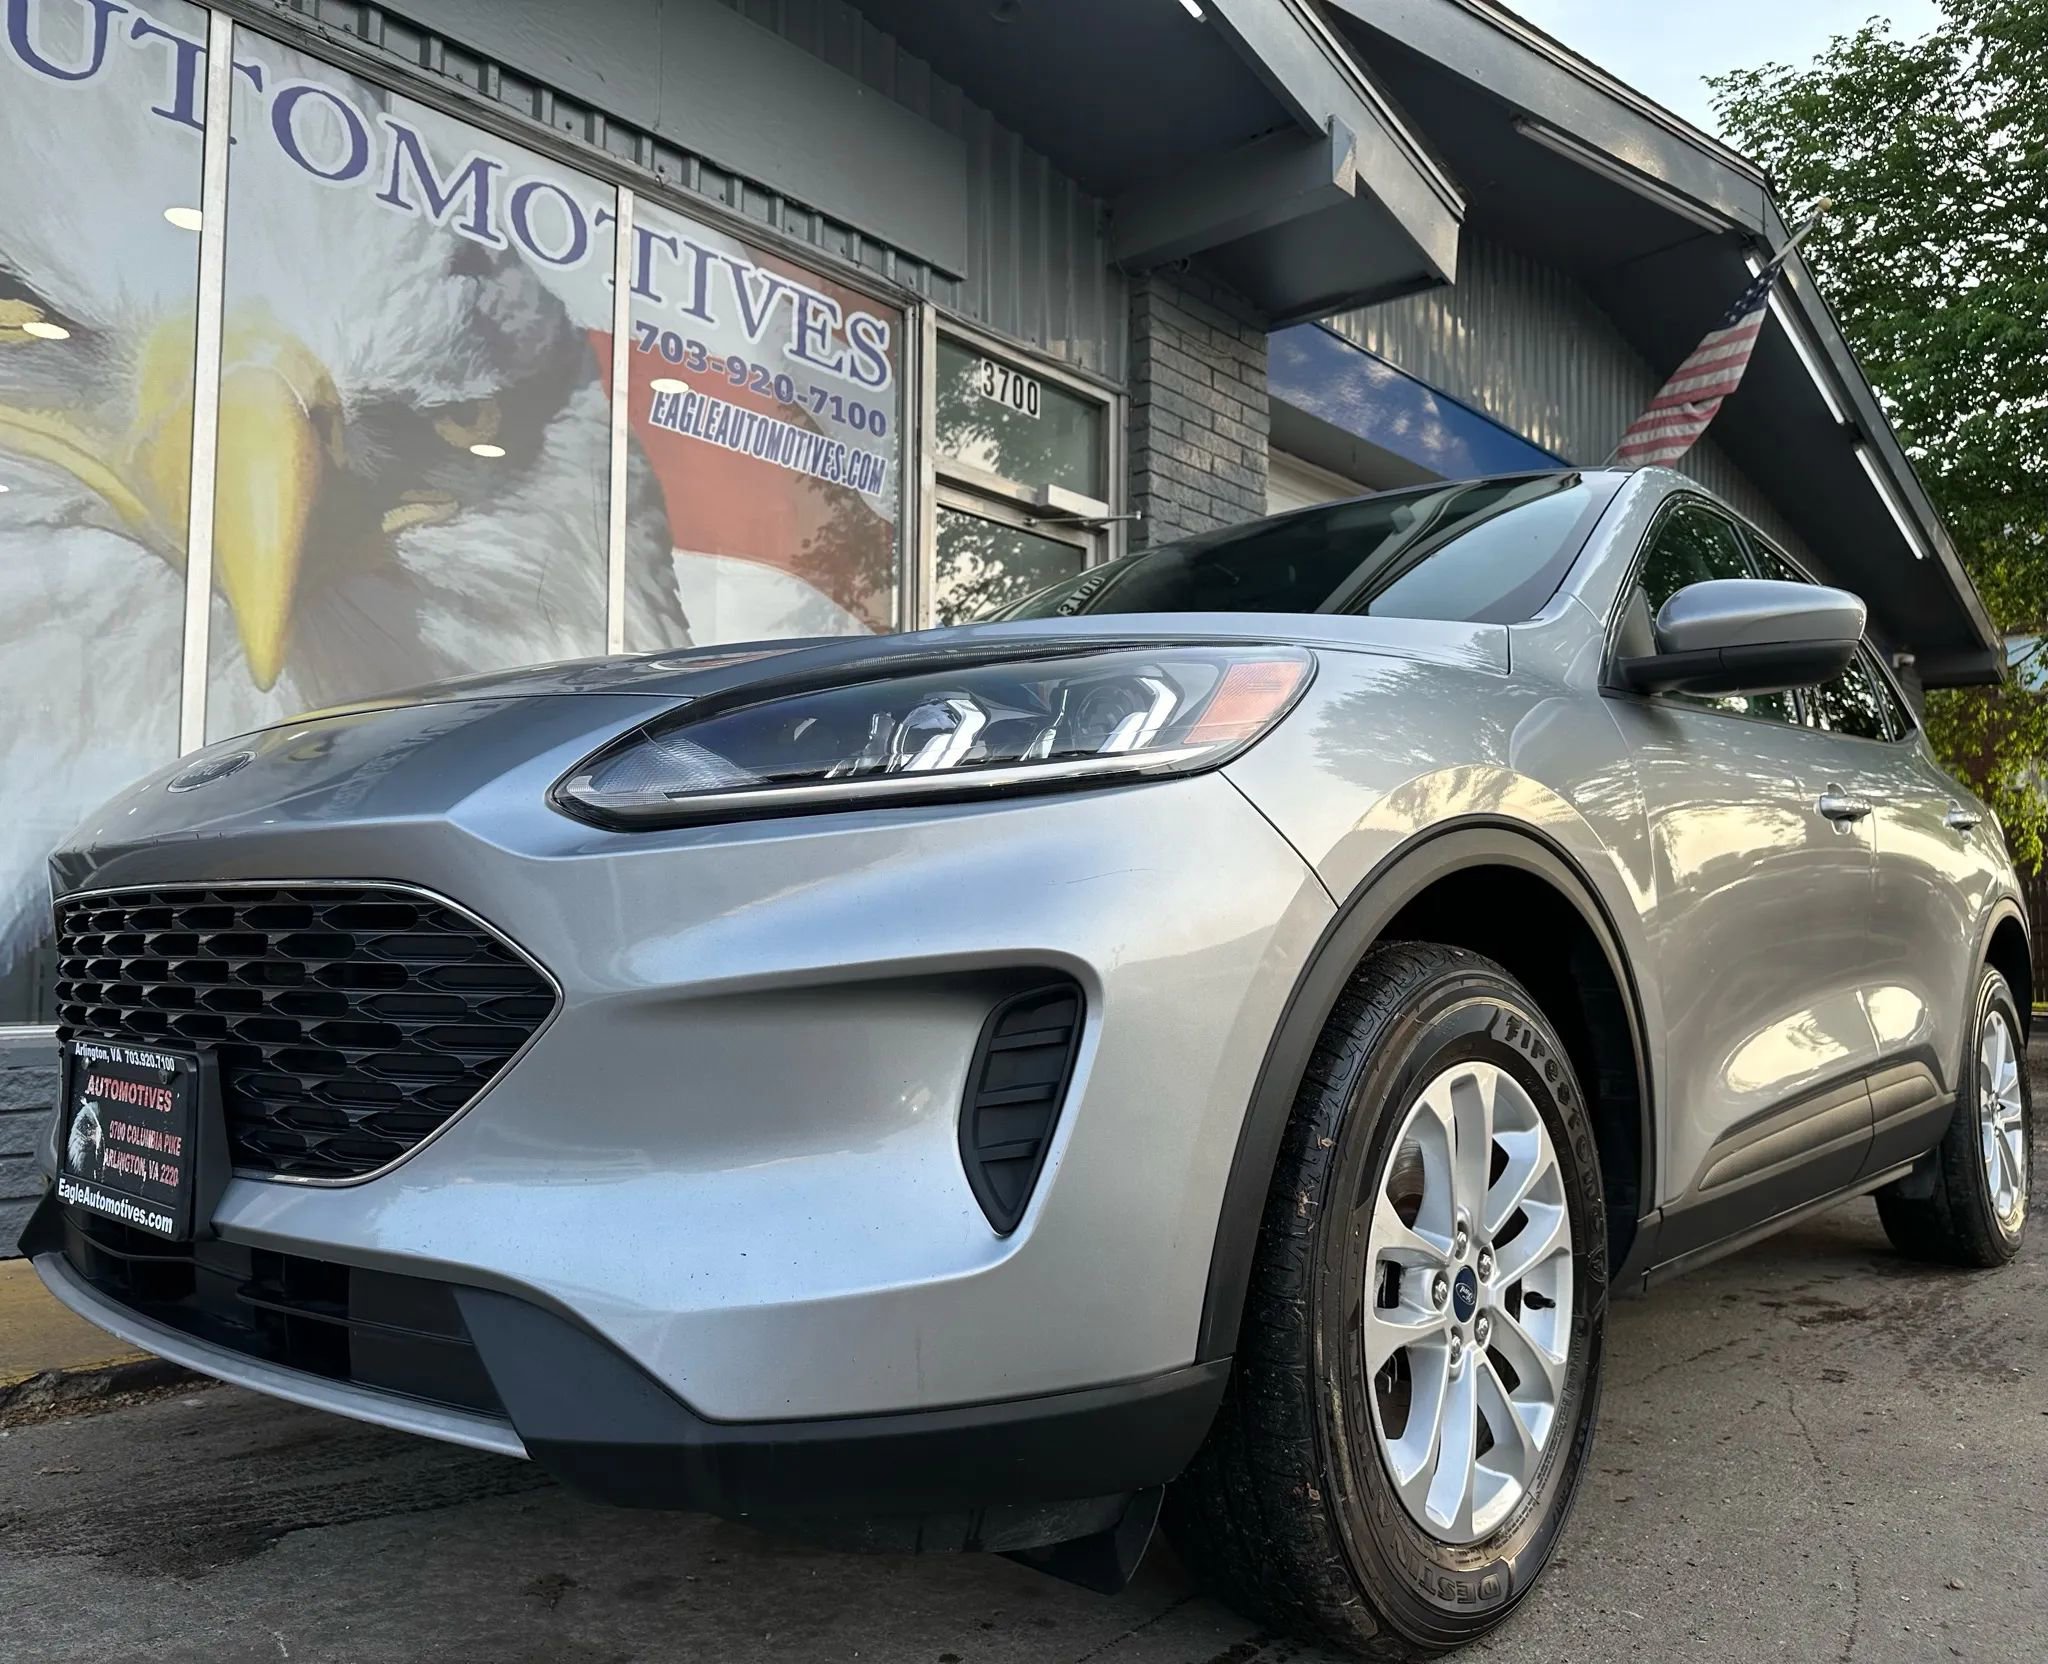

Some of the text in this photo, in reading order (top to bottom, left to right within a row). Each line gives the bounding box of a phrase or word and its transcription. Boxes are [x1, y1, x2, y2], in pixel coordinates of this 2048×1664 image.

[634, 319, 887, 439] 703-920-7100
[983, 361, 1038, 416] 3700
[649, 388, 887, 496] EAGLEAUTOMOTIVES.COM
[75, 1042, 175, 1072] Arlington, VA 703.920.7100
[85, 1074, 172, 1112] AUTOMOTIVES
[126, 1124, 163, 1152] COLUMBIA
[163, 1134, 182, 1157] PIKE
[1504, 1013, 1602, 1234] Firestone
[103, 1147, 147, 1182] ARLINGTON,
[148, 1160, 159, 1180] VA
[58, 1178, 173, 1234] EagleAutomotives.com
